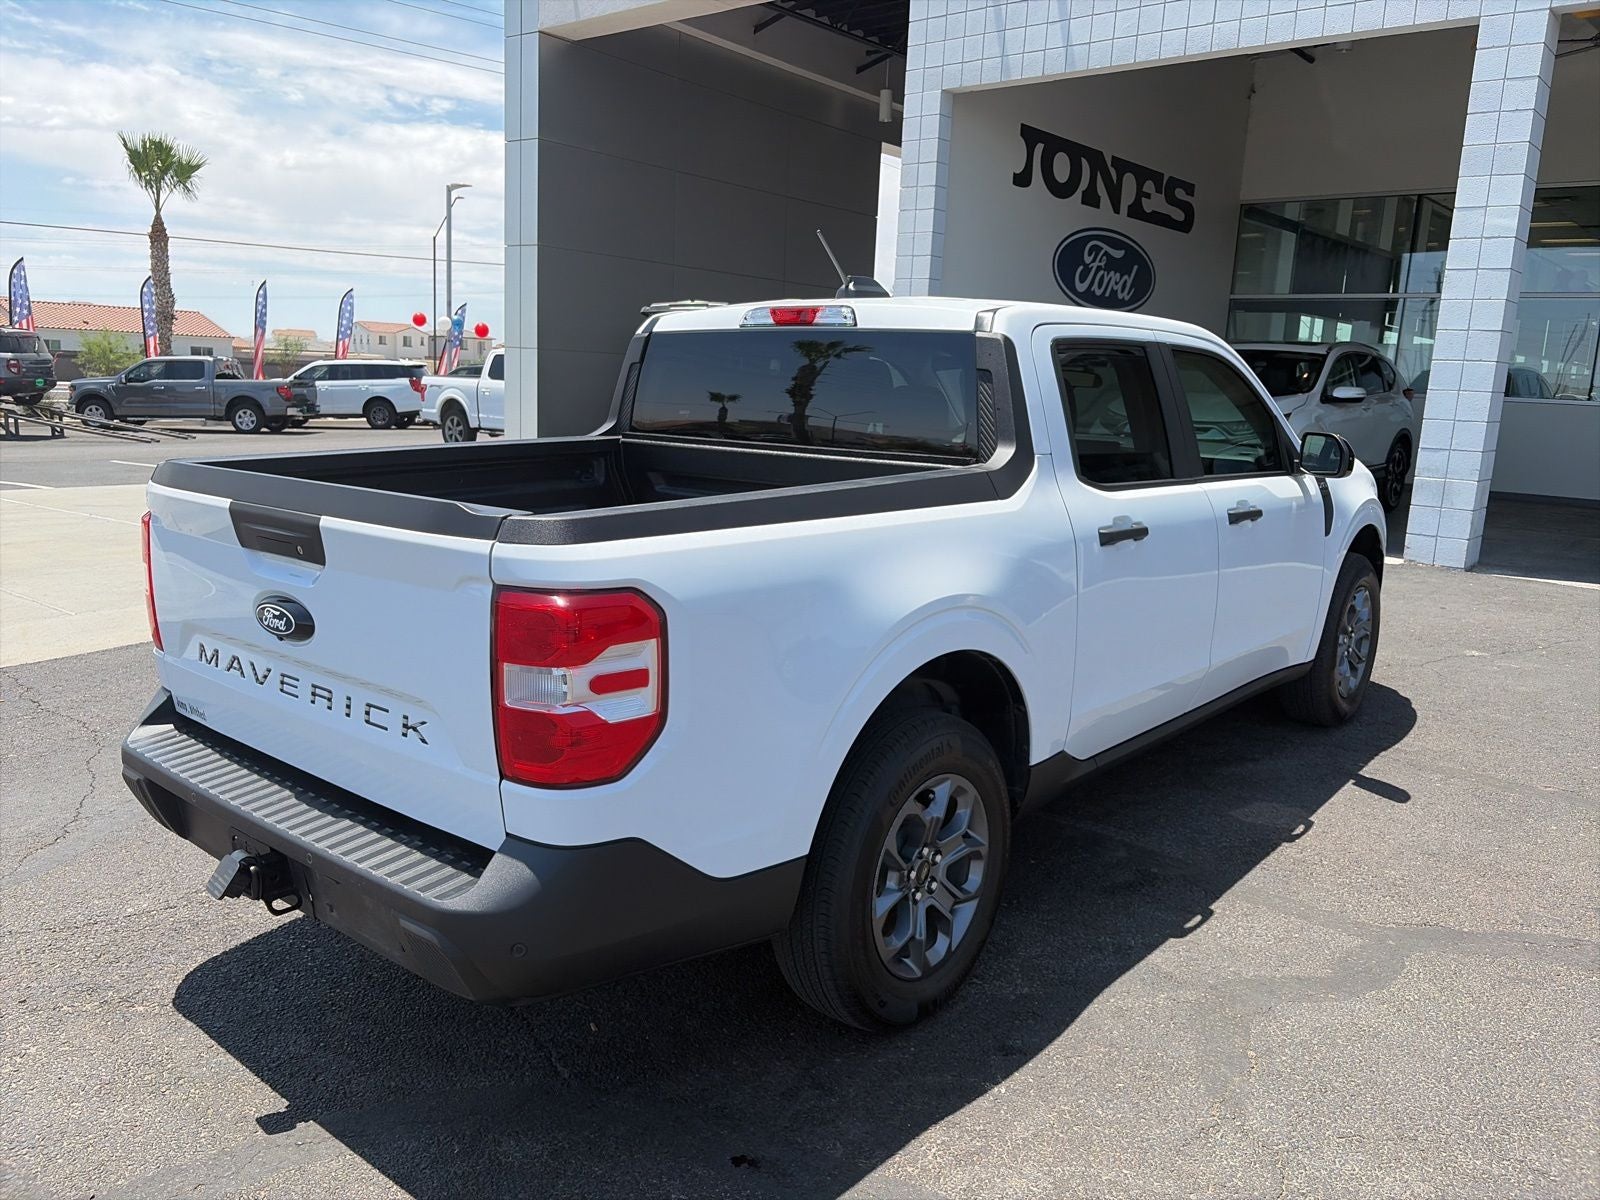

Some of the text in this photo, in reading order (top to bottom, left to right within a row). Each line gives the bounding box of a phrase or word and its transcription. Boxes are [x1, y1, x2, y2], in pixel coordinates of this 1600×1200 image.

[1012, 122, 1196, 234] JONES
[1074, 240, 1138, 301] Ford
[263, 607, 287, 631] Ford
[198, 641, 429, 745] MAVERICK
[887, 741, 945, 807] Continental
